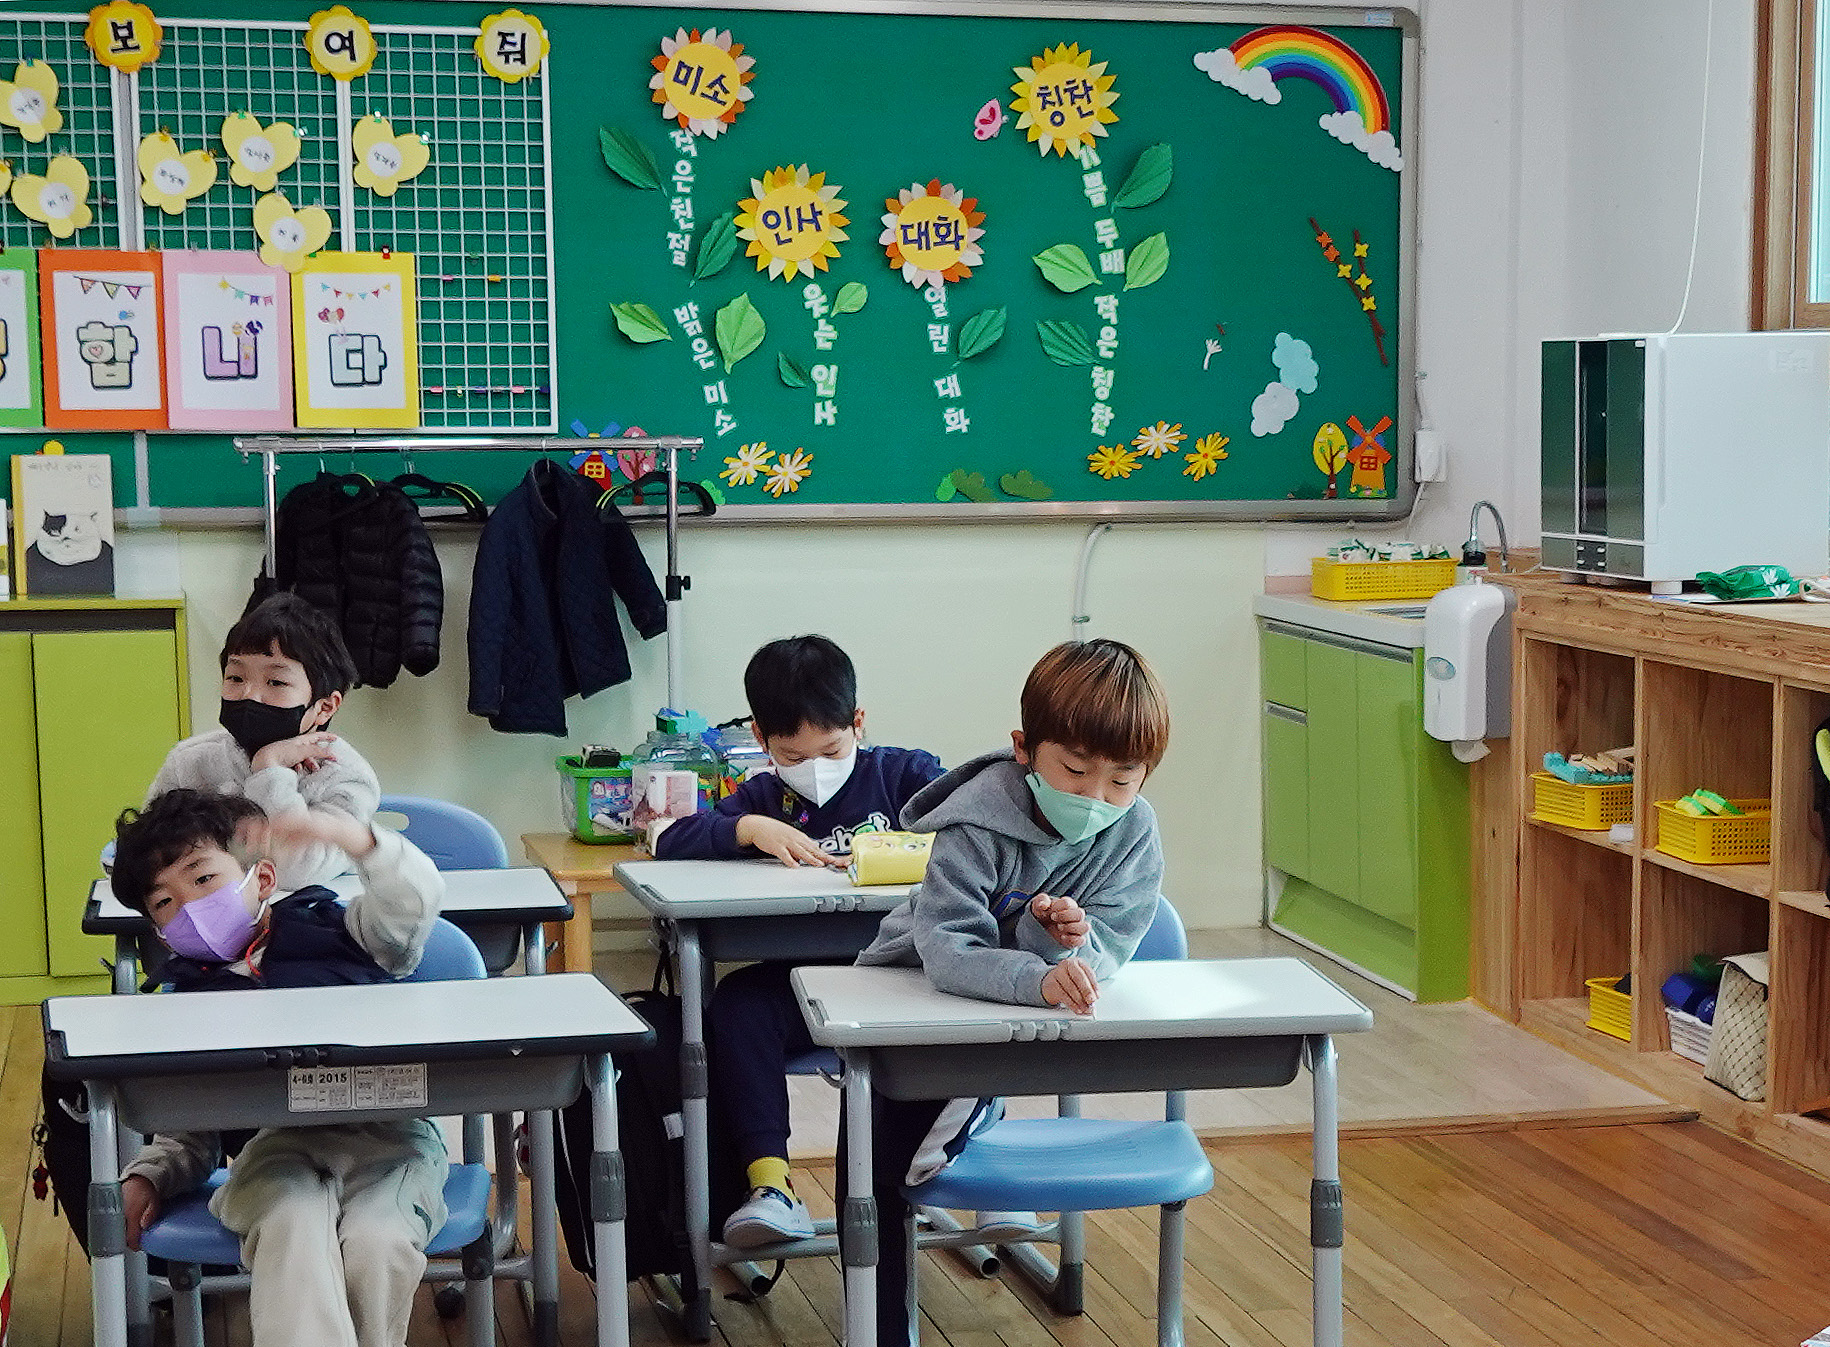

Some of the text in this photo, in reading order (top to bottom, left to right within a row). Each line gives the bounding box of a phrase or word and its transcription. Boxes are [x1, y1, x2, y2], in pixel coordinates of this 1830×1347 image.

[110, 20, 528, 66] 보 여 줘
[672, 60, 731, 106] 미소
[1037, 79, 1095, 127] 칭찬
[762, 202, 824, 246] 인사
[900, 215, 965, 251] 대화
[1094, 294, 1119, 359] 작은
[673, 301, 737, 437] 밝은 미소
[803, 283, 839, 426] 웃는 인사
[924, 286, 970, 434] 열린 대화
[1090, 366, 1115, 438] 칭찬
[319, 1072, 347, 1083] 2015
